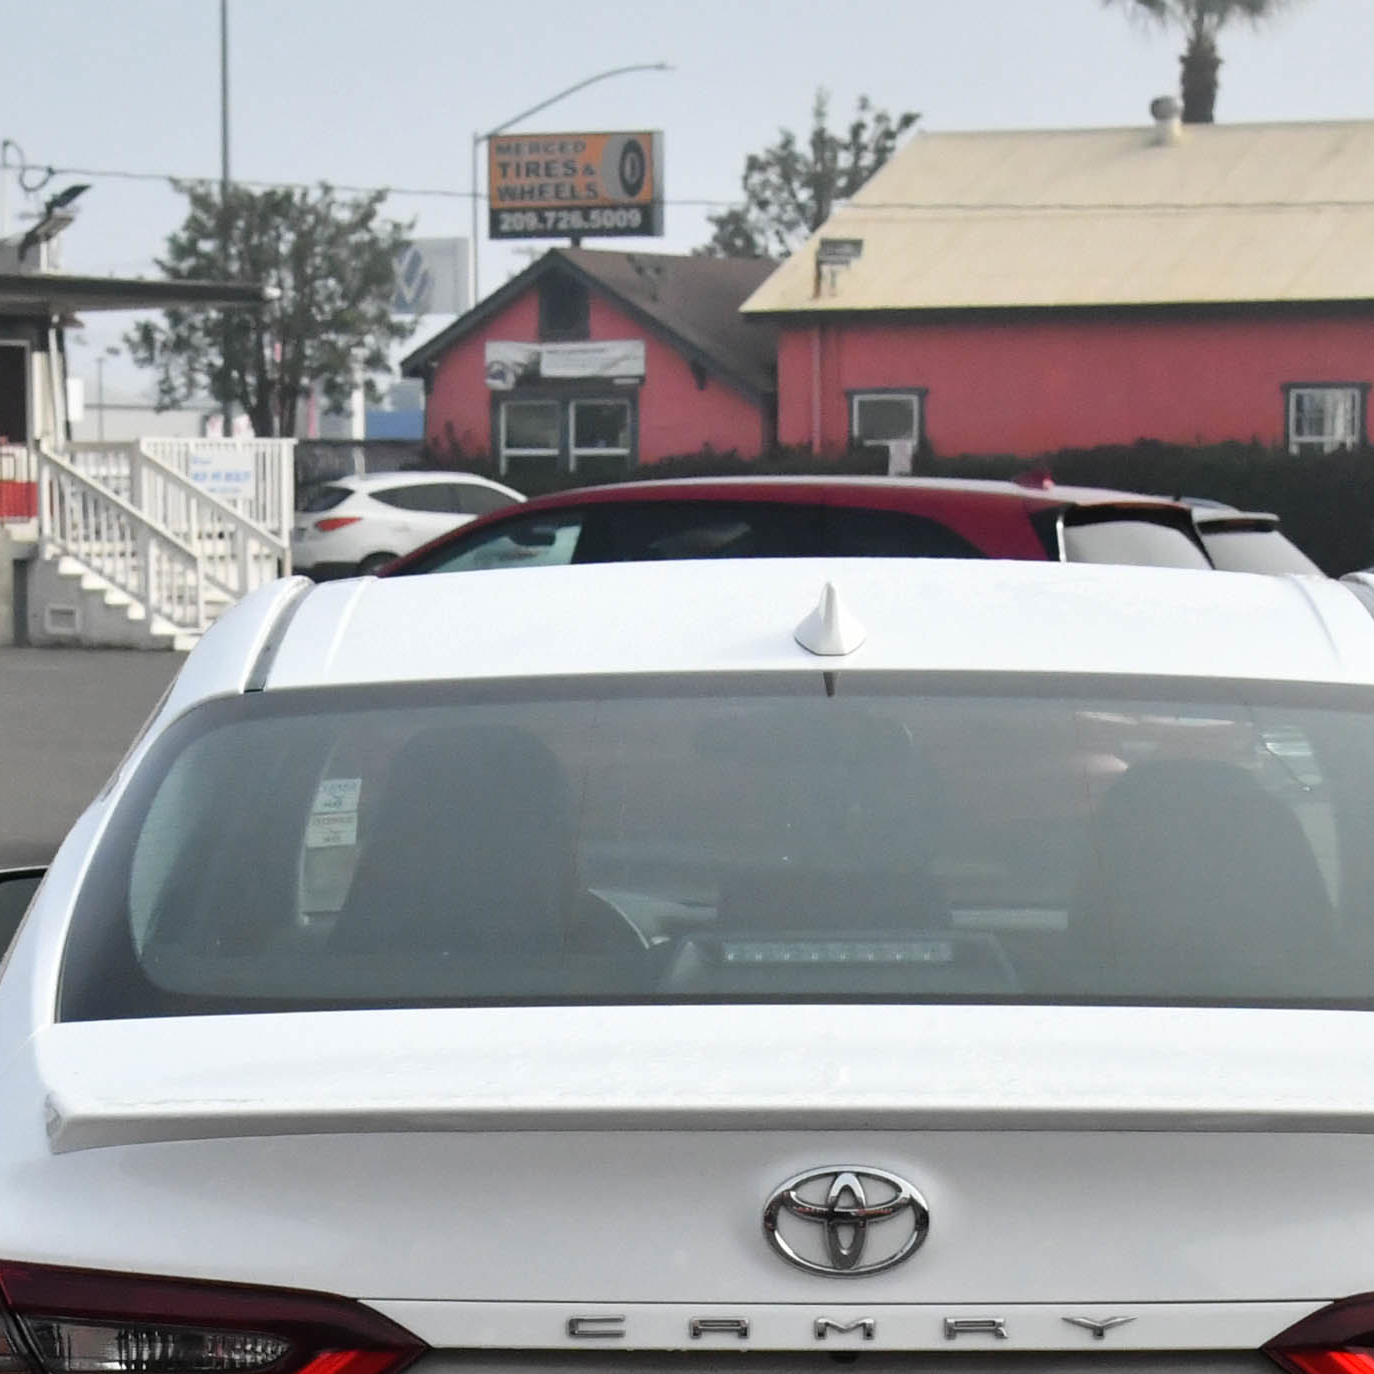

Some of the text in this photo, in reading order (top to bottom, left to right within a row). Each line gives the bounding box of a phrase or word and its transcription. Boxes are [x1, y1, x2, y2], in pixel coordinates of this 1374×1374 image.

[497, 161, 595, 178] TIRES &
[497, 182, 599, 200] WHEELS
[566, 1315, 1138, 1340] CAMRY
